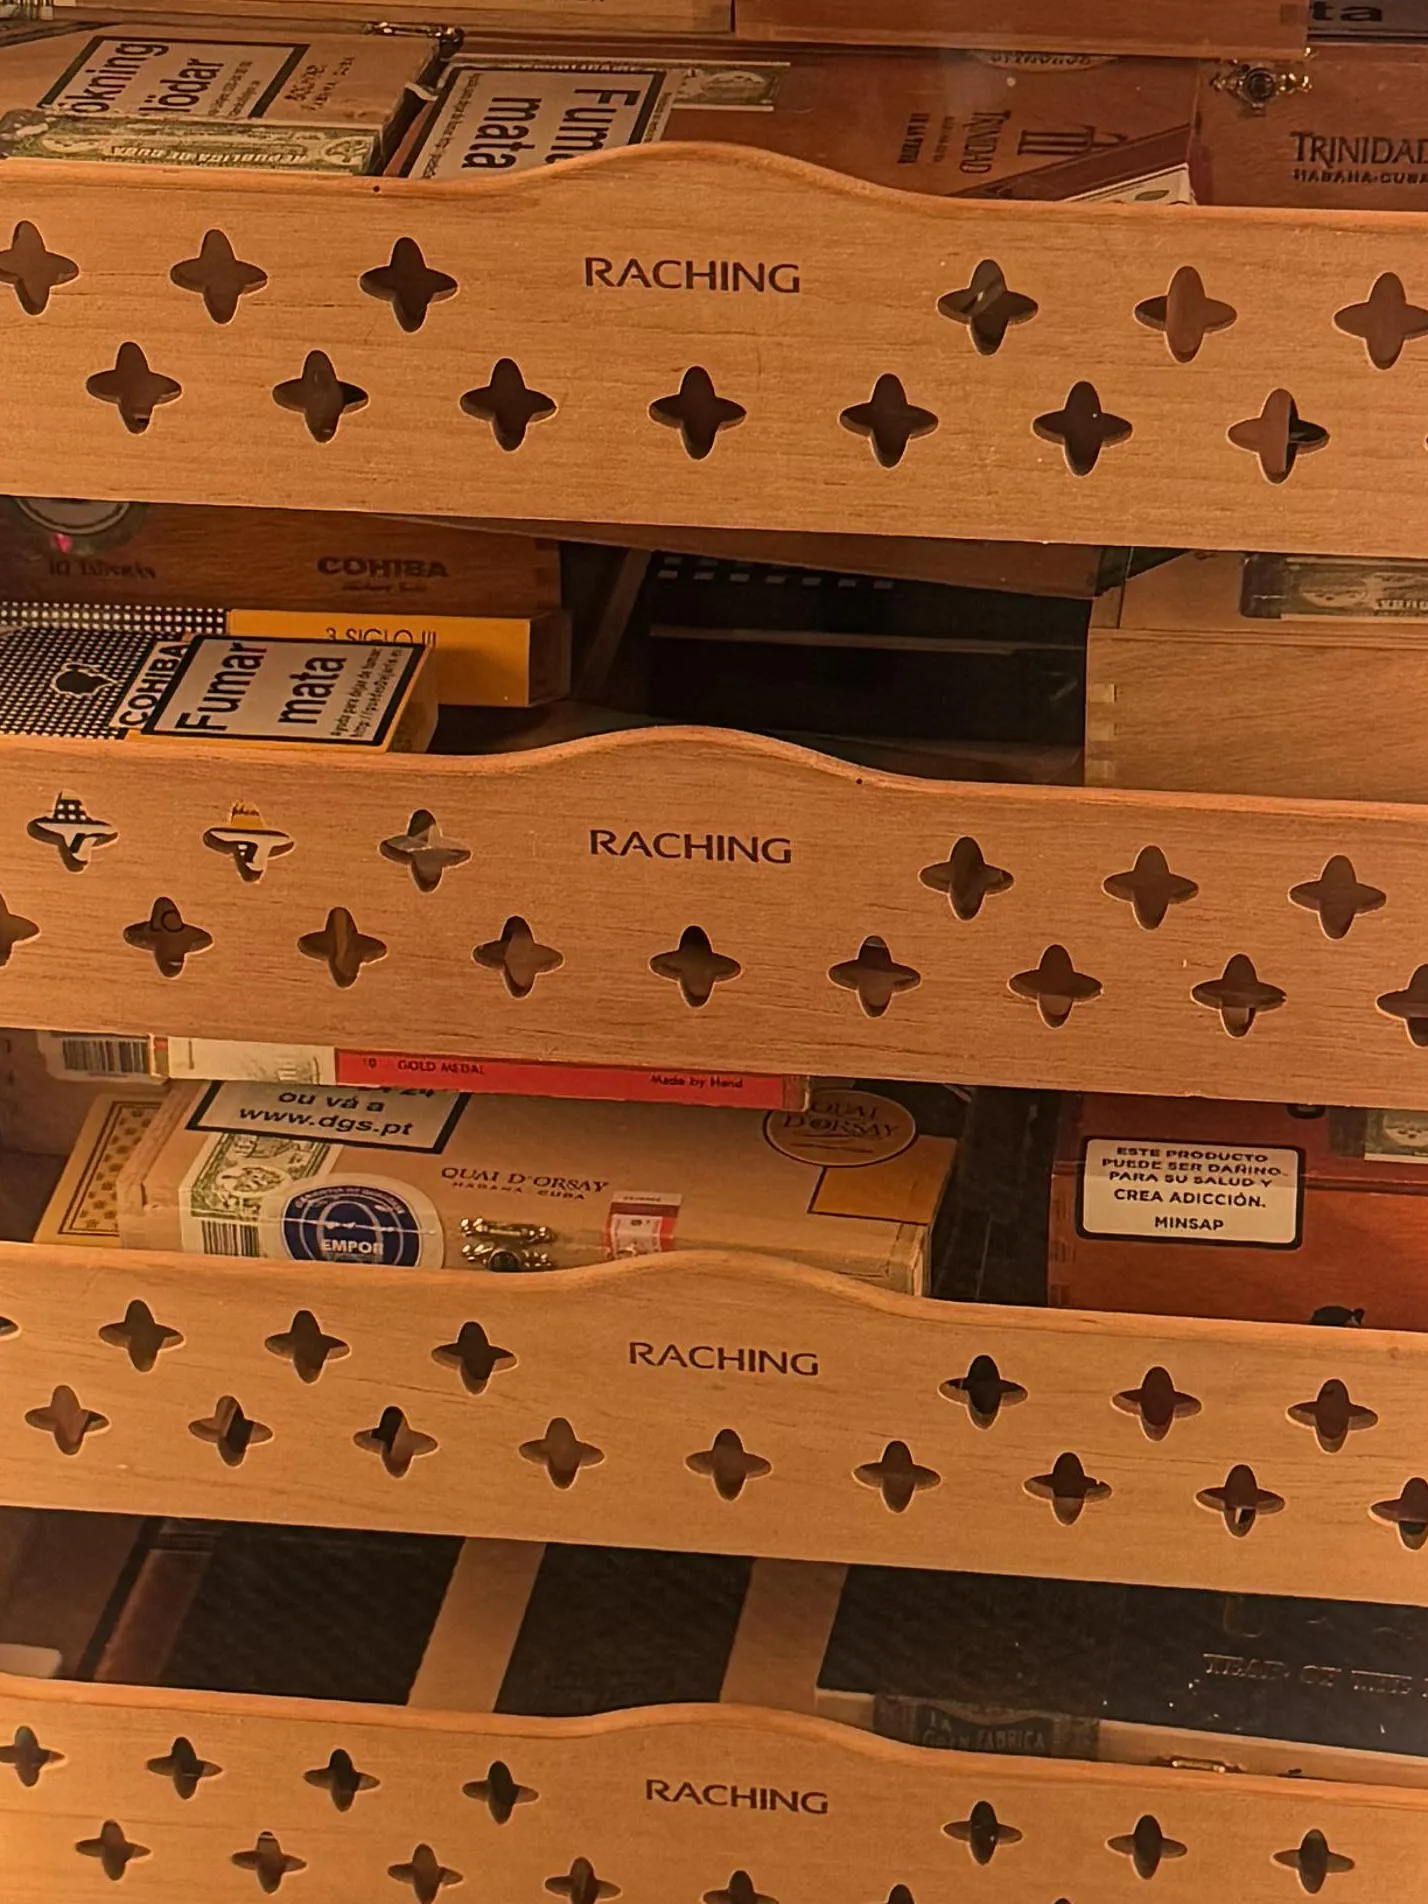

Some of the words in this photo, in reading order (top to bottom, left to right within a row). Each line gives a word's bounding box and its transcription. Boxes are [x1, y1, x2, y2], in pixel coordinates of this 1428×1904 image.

[461, 96, 543, 170] mata
[585, 256, 800, 294] RACHING
[317, 556, 449, 579] COHIBA
[119, 645, 189, 728] COHIBA
[174, 641, 267, 732] Fumar
[277, 656, 347, 725] mata
[589, 829, 792, 864] RACHING
[397, 1059, 437, 1073] GOLD
[440, 1063, 485, 1076] MEDAL
[651, 1074, 685, 1087] Made
[689, 1076, 706, 1089] by
[709, 1075, 744, 1089] Hand
[278, 1092, 315, 1106] ou
[326, 1095, 359, 1109] vá
[367, 1101, 385, 1113] a
[239, 1106, 414, 1137] www.dgs.pt
[1102, 1158, 1162, 1170] PUEDE
[1168, 1161, 1202, 1172] SER
[1116, 1147, 1161, 1158] ESTE
[1166, 1150, 1269, 1163] PRODUCTO
[440, 1166, 500, 1185] QUAI
[509, 1171, 610, 1195] D'ORSAY
[1109, 1171, 1160, 1183] PARA
[1164, 1174, 1188, 1185] SU
[1194, 1176, 1255, 1188] SALUD
[1259, 1179, 1273, 1189] Y
[1114, 1188, 1164, 1203] CREA
[1169, 1191, 1267, 1208] ADICCIÓN.
[1154, 1216, 1224, 1231] MINSAP
[629, 1342, 819, 1376] RACHING
[645, 1779, 829, 1815] RACHING
